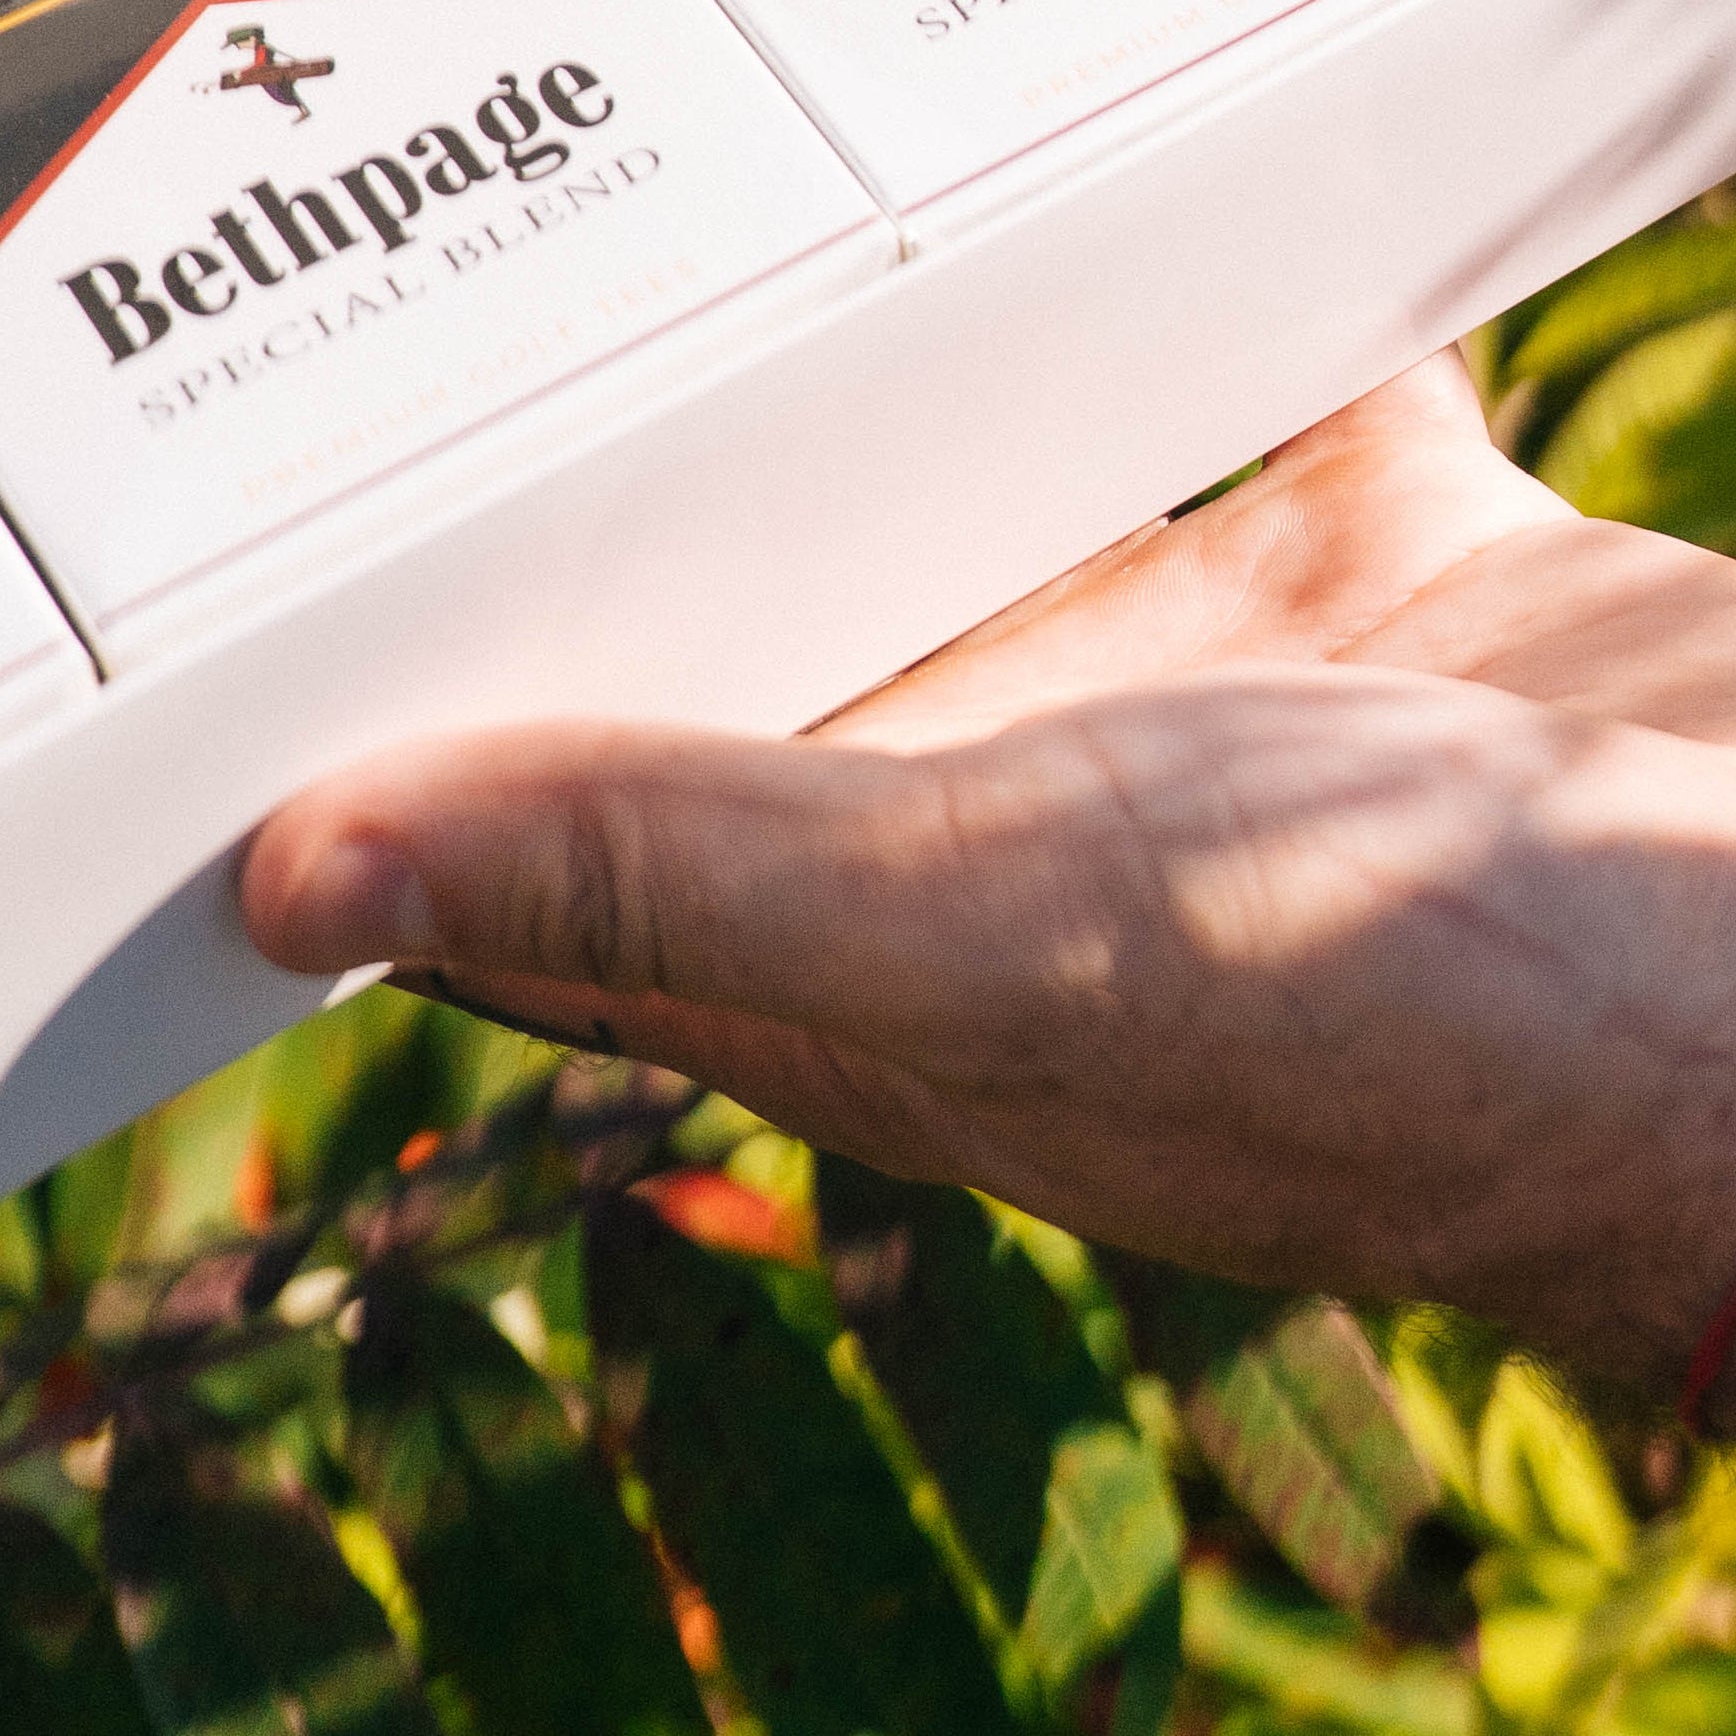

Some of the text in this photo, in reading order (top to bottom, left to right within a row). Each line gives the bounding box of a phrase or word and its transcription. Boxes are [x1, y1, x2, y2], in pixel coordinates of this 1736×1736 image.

[58, 59, 615, 366] Bethpage
[138, 146, 663, 427] SPECIAL BLEND
